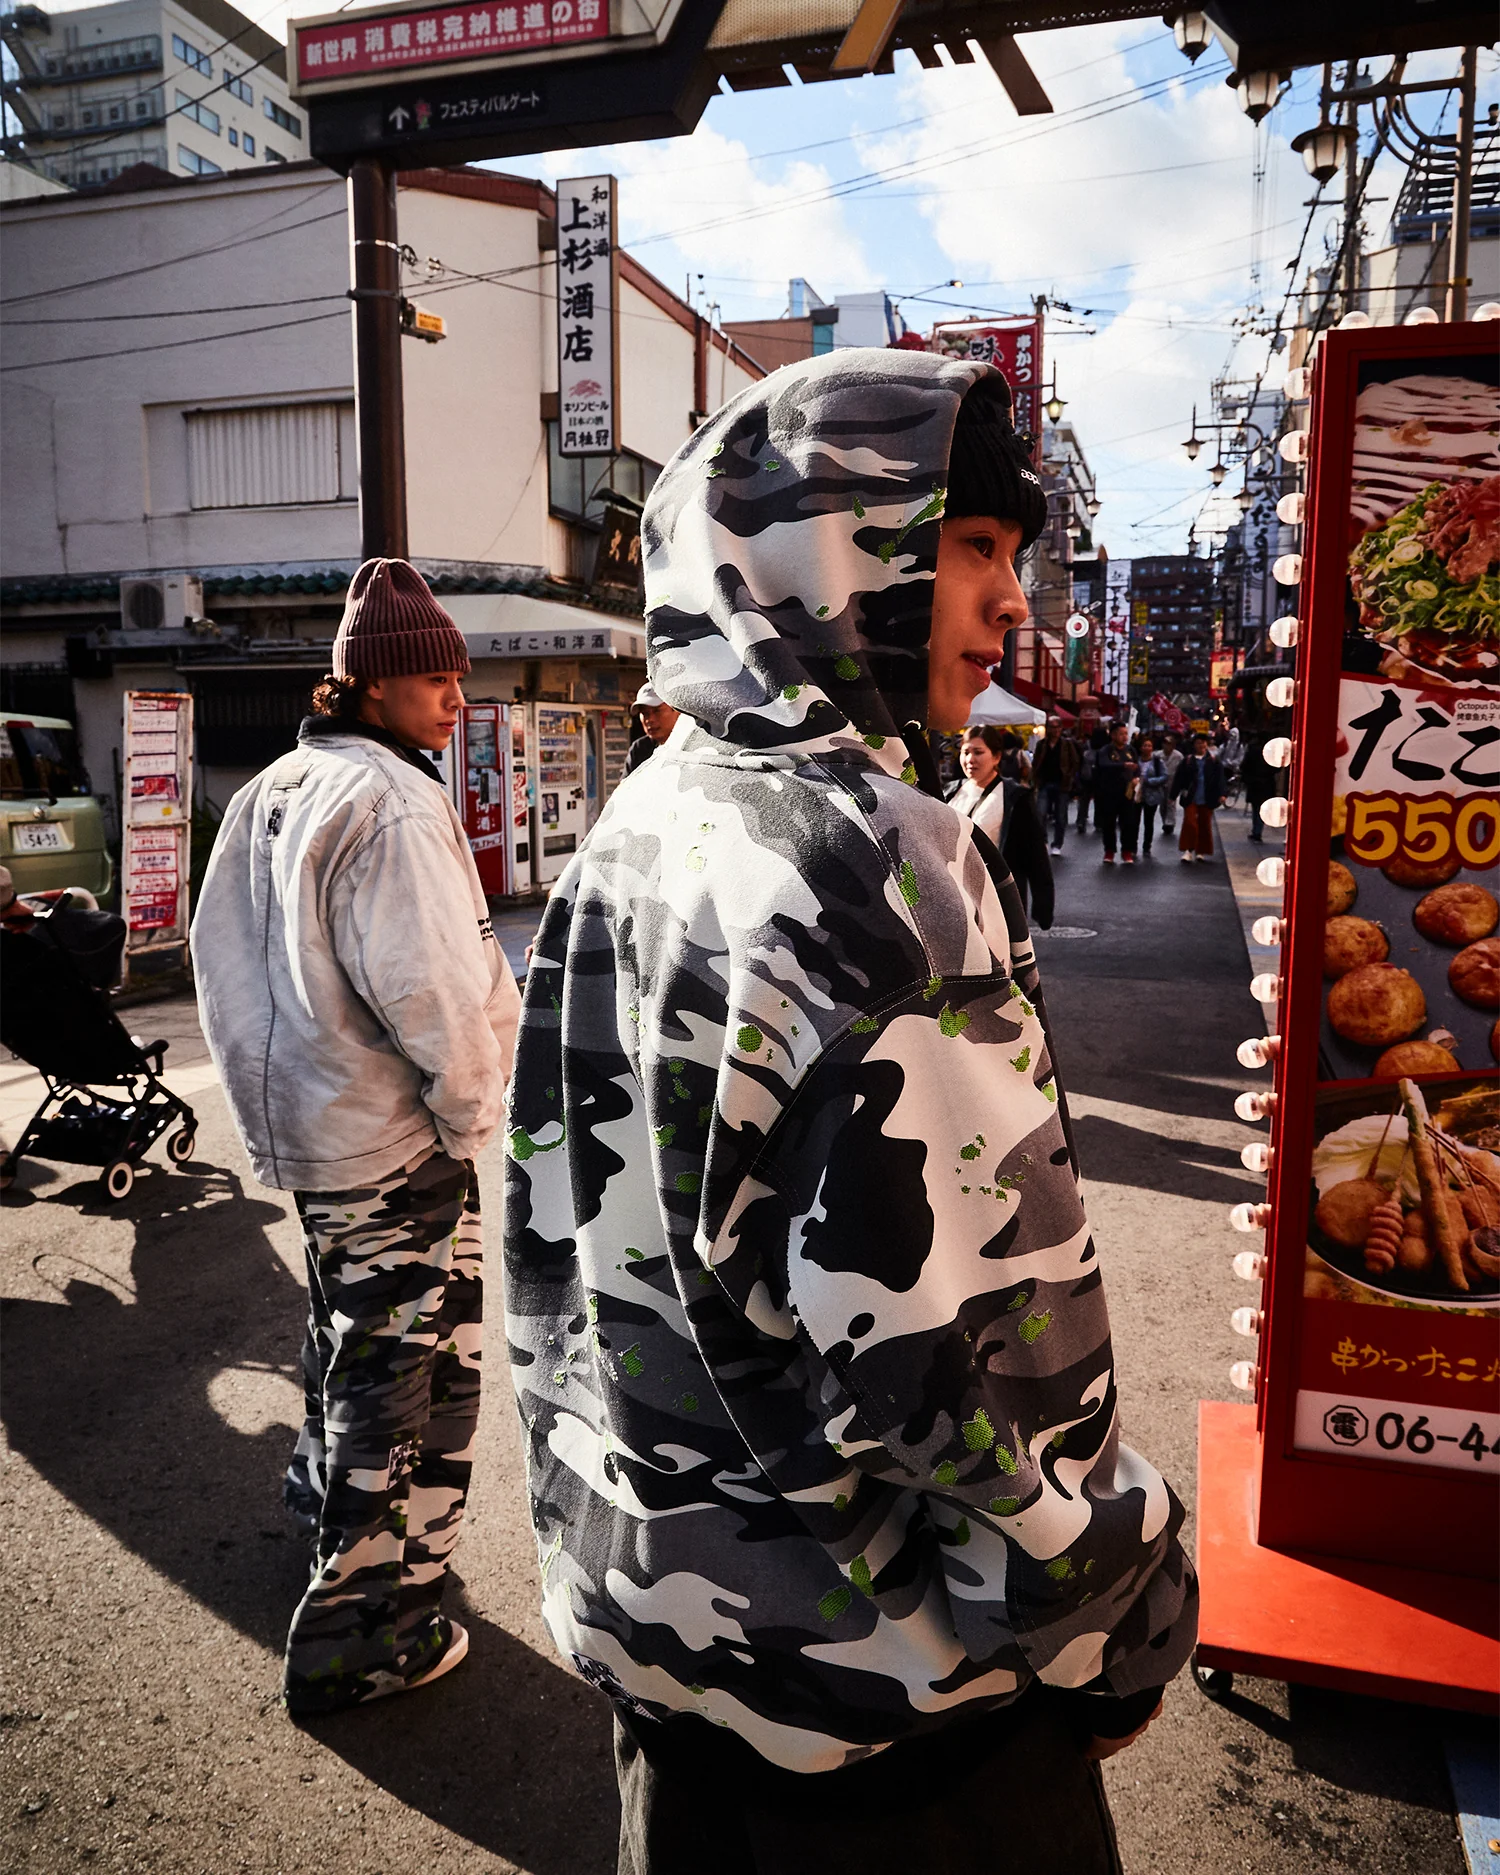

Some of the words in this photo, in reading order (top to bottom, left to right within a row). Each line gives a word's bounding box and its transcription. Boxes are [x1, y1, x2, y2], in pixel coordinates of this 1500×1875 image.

[306, 37, 358, 66] 新世界
[365, 0, 601, 53] 消費税完納推進の街
[440, 90, 541, 120] フェスティバルゲート
[591, 185, 610, 258] 和洋酒
[560, 196, 595, 364] 上杉酒店
[564, 400, 609, 413] キリンビール
[563, 429, 609, 448] 月桂冠
[490, 634, 606, 652] たばこ・和洋酒
[1457, 702, 1489, 711] Octopus
